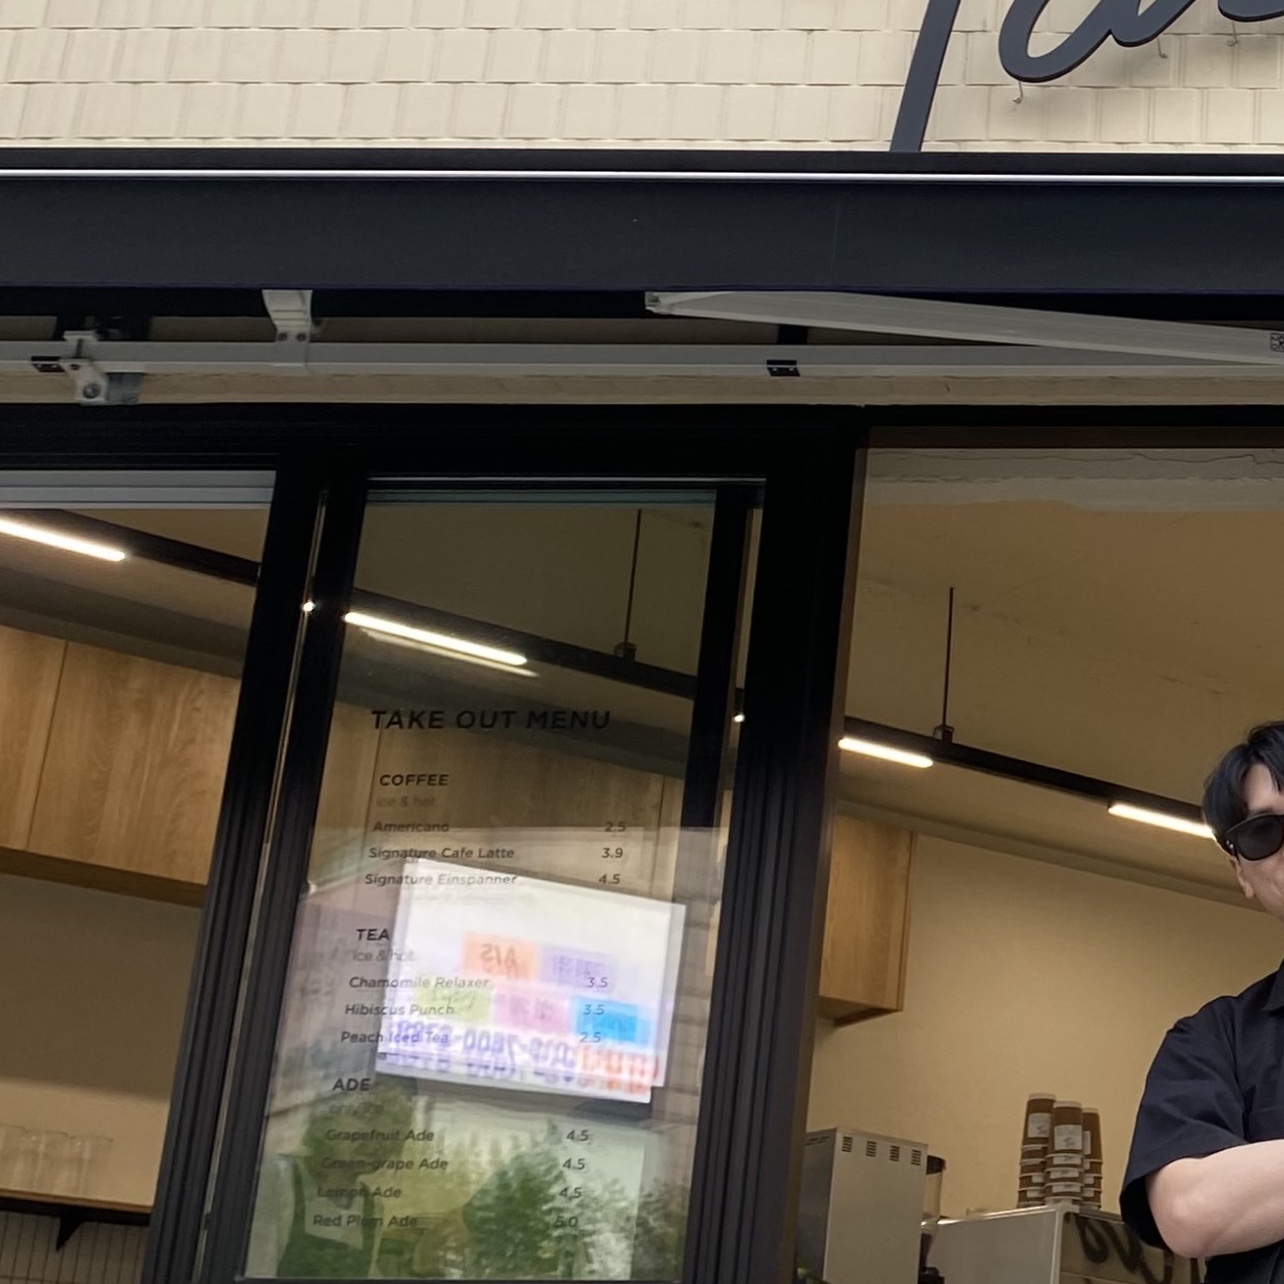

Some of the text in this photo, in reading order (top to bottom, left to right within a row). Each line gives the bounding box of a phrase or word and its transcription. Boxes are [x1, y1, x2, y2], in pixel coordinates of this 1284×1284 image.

[371, 710, 611, 730] TAKE OUT MENU
[379, 774, 449, 786] COFFEE
[373, 820, 450, 833] Americano
[604, 821, 627, 833] 2.5
[368, 847, 514, 860] Signature Cafe Latte
[602, 847, 623, 859] 3.9
[364, 873, 517, 887] Signature Einspanner
[598, 873, 620, 885] 4.5
[356, 928, 390, 941] TEA
[349, 975, 490, 989] Chamomile Relaxer
[587, 976, 609, 988] 3.5
[345, 1003, 454, 1016] Hibiscus Punch
[583, 1003, 605, 1015] 3.5
[341, 1031, 449, 1044] Peach Iced Tea
[579, 1031, 601, 1044] 2.5
[333, 1078, 371, 1091] ADE
[326, 1129, 434, 1144] Grapefruit Ade
[566, 1129, 590, 1142] 4.5
[418, 1157, 448, 1170] Ade
[562, 1158, 585, 1170] 4.5
[317, 1186, 402, 1199] Lemon Ade
[558, 1187, 582, 1199] 4.5
[313, 1215, 342, 1227] Red
[387, 1214, 418, 1227] Ade
[554, 1216, 578, 1228] 5.0
